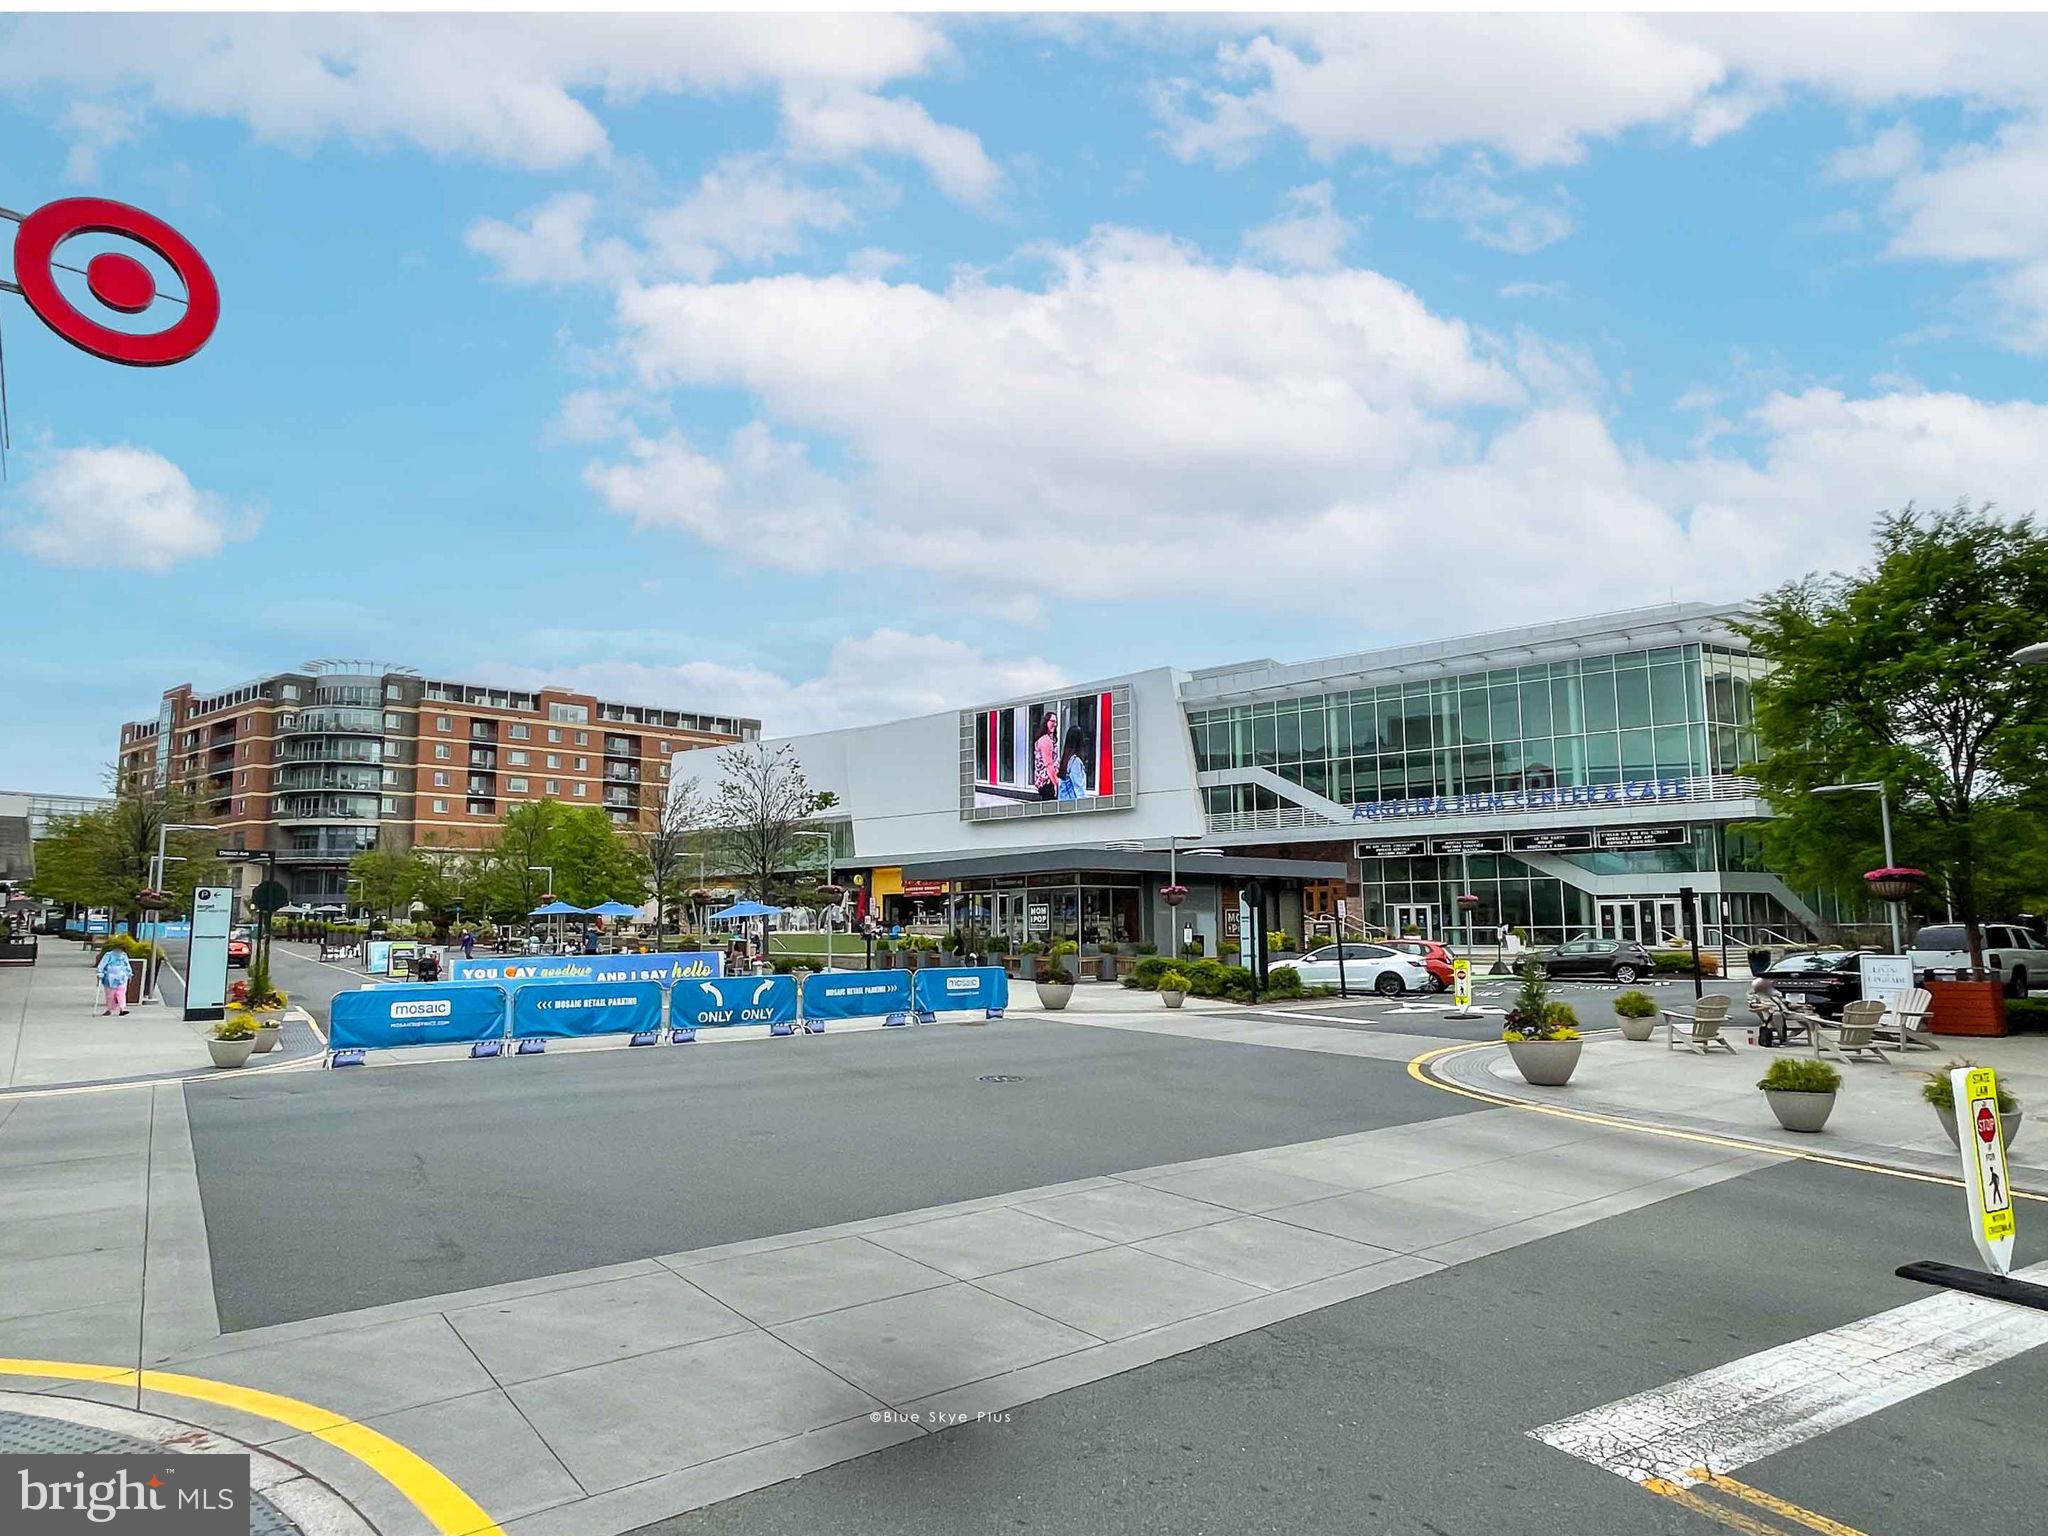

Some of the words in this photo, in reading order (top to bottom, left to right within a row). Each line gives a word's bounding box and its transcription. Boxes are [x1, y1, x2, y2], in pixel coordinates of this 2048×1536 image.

[1352, 797, 1447, 820] ANGELIKA
[1456, 793, 1505, 812] FILM
[1514, 785, 1599, 807] CENTER
[1605, 784, 1617, 801] &
[462, 968, 498, 980] YOU
[597, 972, 627, 982] AND
[631, 971, 636, 980] I
[640, 969, 668, 980] SAY
[672, 960, 714, 979] hello
[395, 1003, 446, 1015] mosaic
[554, 1000, 582, 1009] MOSAIC
[583, 998, 607, 1008] RETAIL
[607, 997, 638, 1006] PARKING
[697, 1010, 734, 1023] ONLY
[741, 1007, 774, 1021] ONLY
[1972, 1072, 1990, 1085] STATE
[1978, 1118, 1995, 1132] STOP
